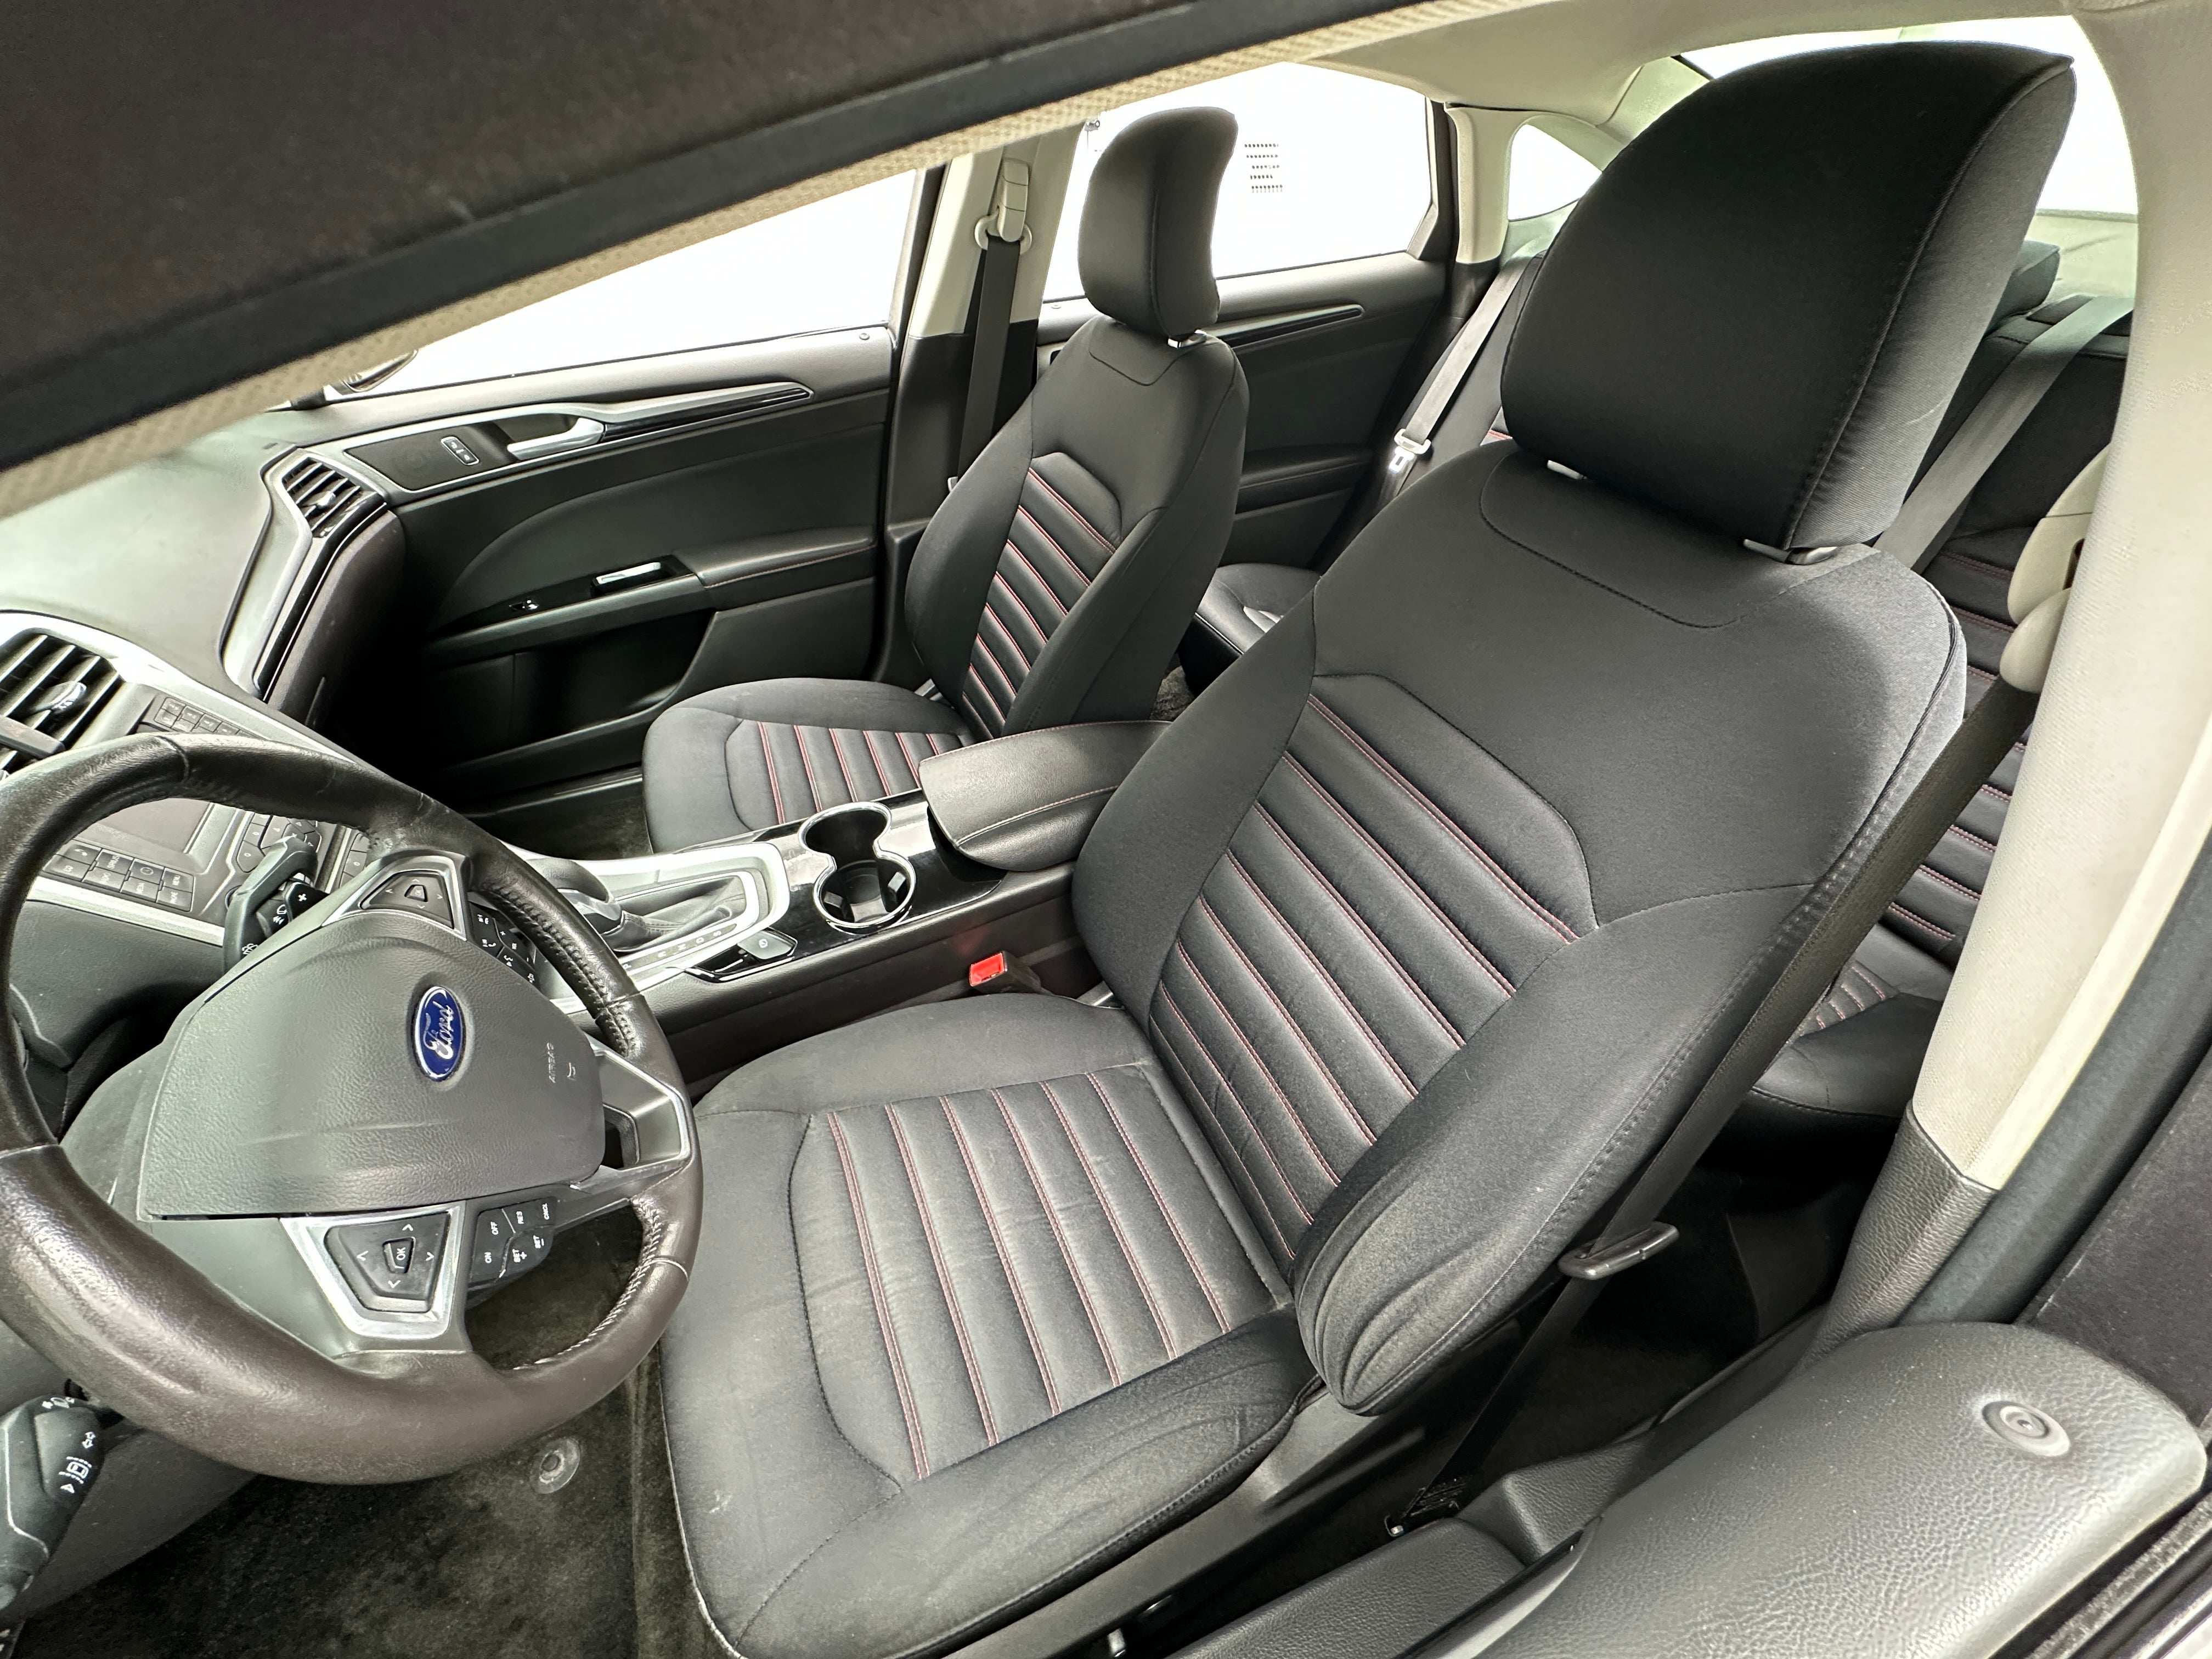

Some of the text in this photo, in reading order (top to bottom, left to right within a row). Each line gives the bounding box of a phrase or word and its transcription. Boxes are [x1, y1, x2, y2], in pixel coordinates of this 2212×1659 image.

[423, 1001, 454, 1059] Ford
[516, 1211, 524, 1224] RES
[490, 1221, 499, 1235] OFF
[533, 1235, 541, 1249] SET
[396, 1247, 406, 1261] OK
[484, 1251, 492, 1263] ON
[512, 1249, 521, 1262] SET
